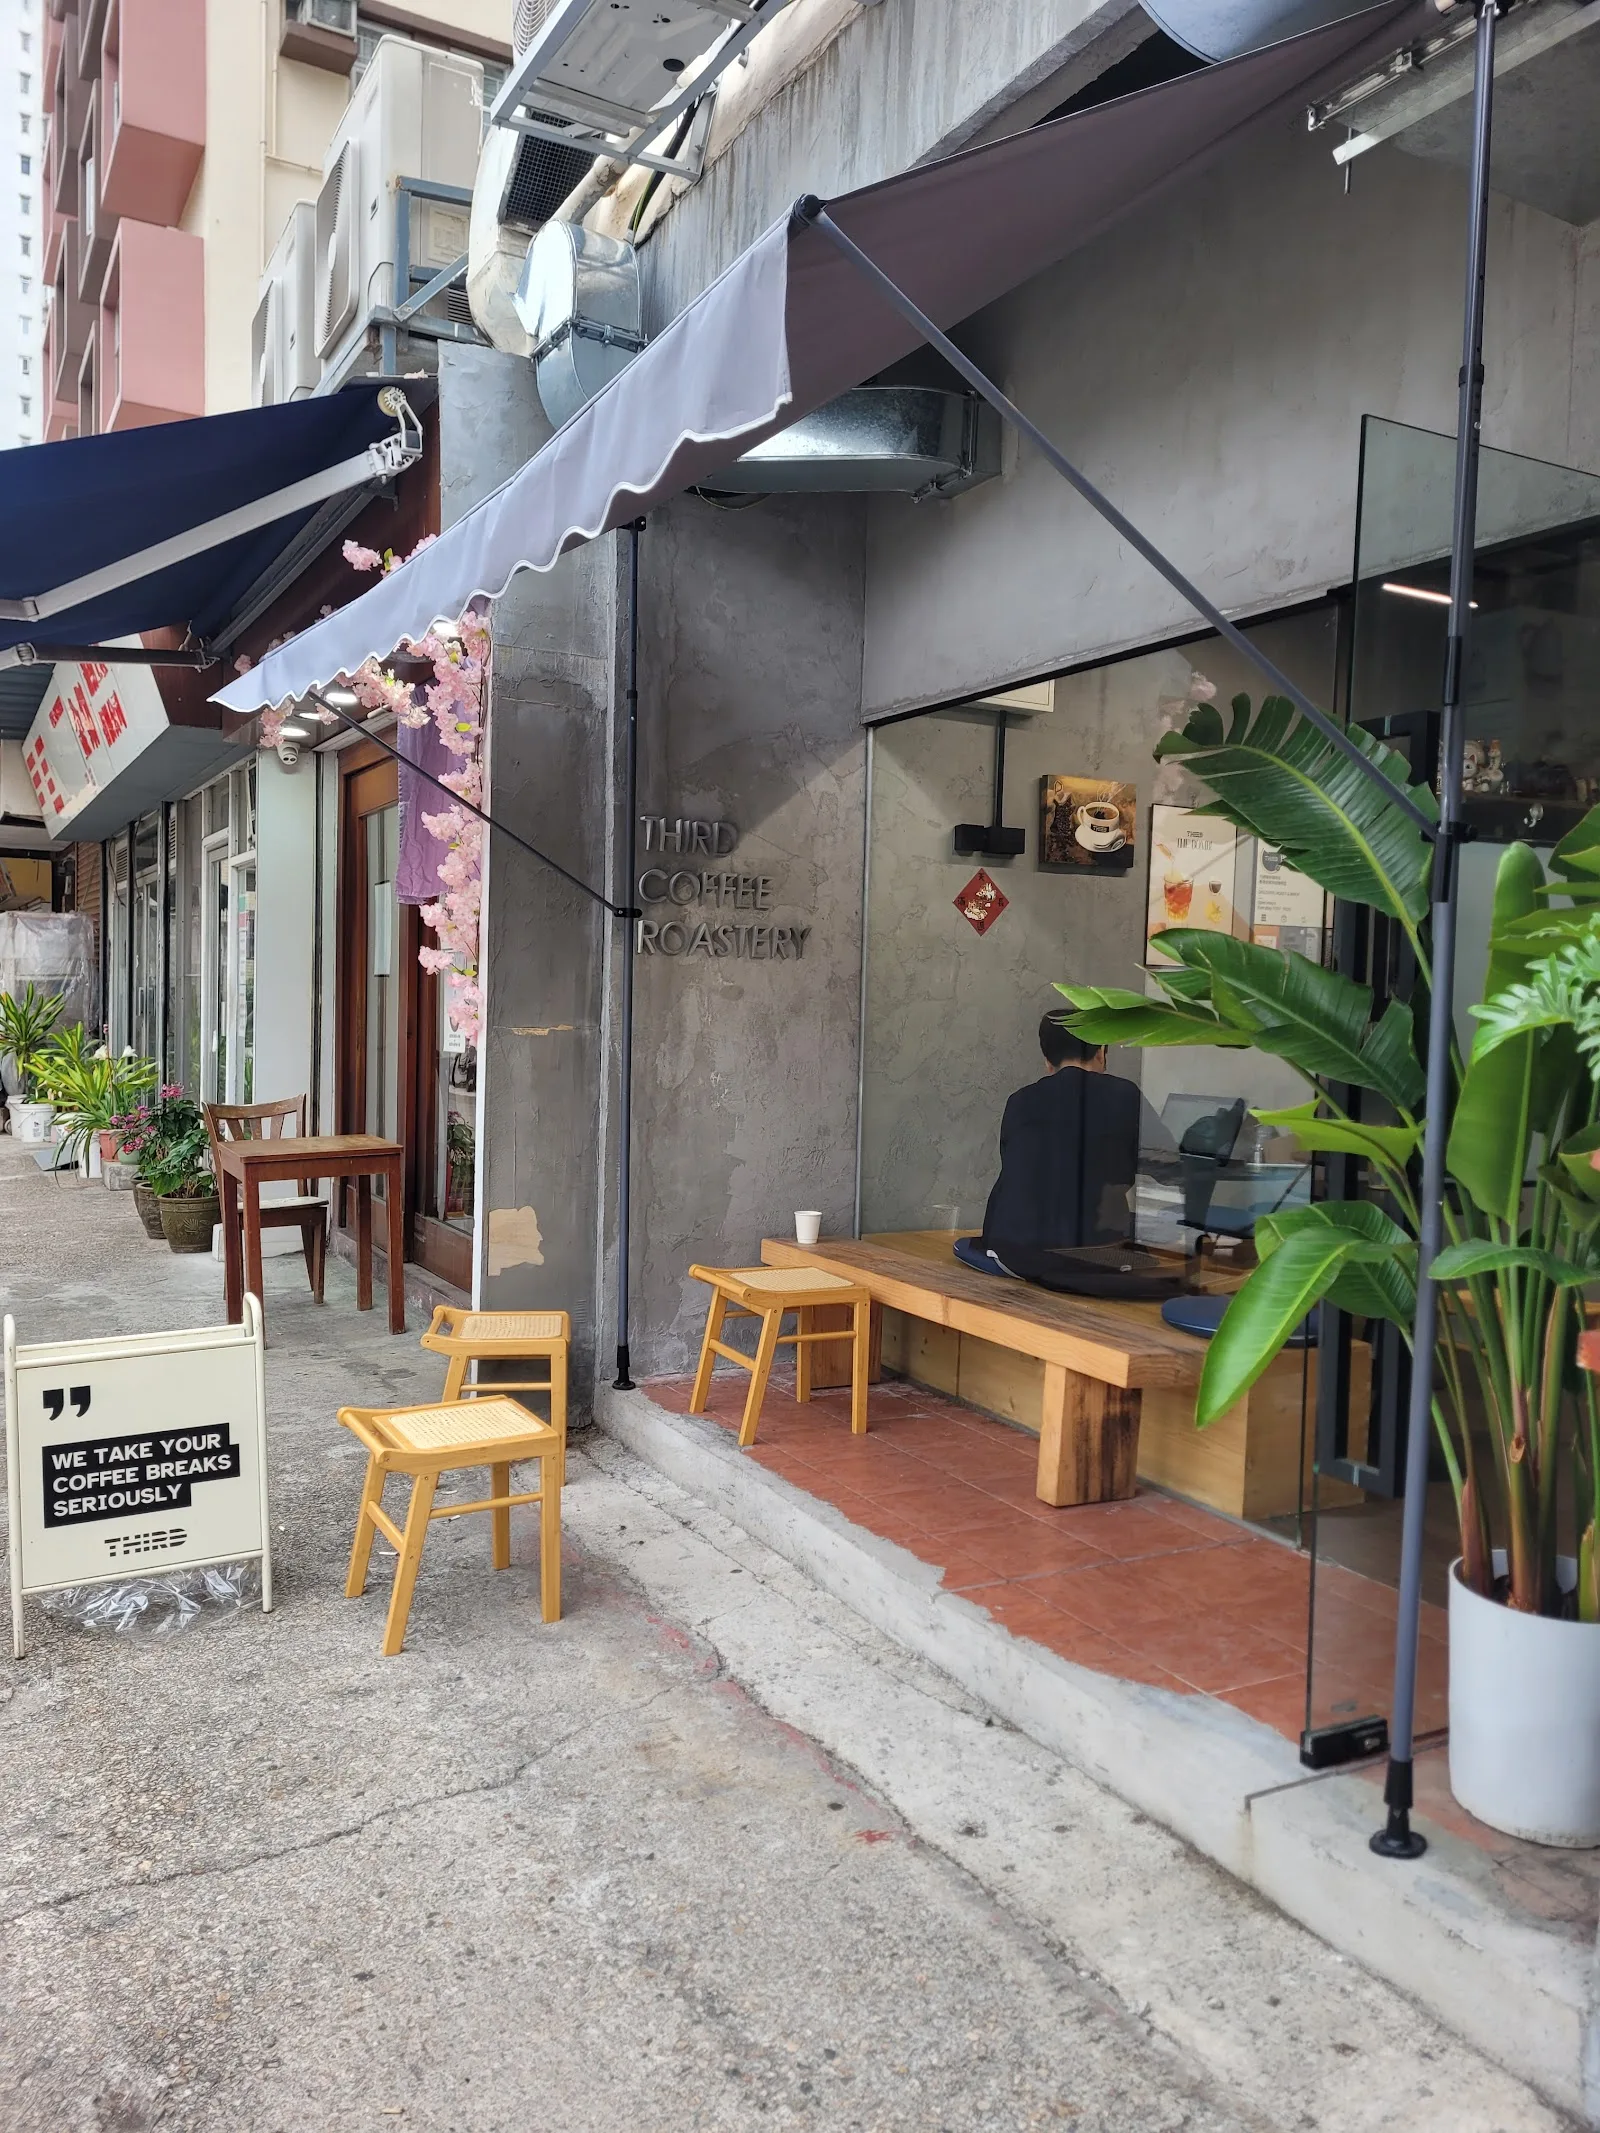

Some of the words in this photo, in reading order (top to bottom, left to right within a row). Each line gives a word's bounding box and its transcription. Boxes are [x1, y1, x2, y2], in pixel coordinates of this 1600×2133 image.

[639, 815, 739, 858] THIRD
[638, 868, 774, 911] COFFEE
[636, 919, 812, 960] ROASTERY
[51, 1450, 87, 1470] WE
[93, 1441, 153, 1465] TAKE
[159, 1433, 222, 1455] YOUR
[52, 1466, 139, 1494] COFFEE
[145, 1454, 232, 1481] BREAKS
[52, 1483, 183, 1517] SERIOUSLY
[104, 1528, 188, 1557] THIRD
